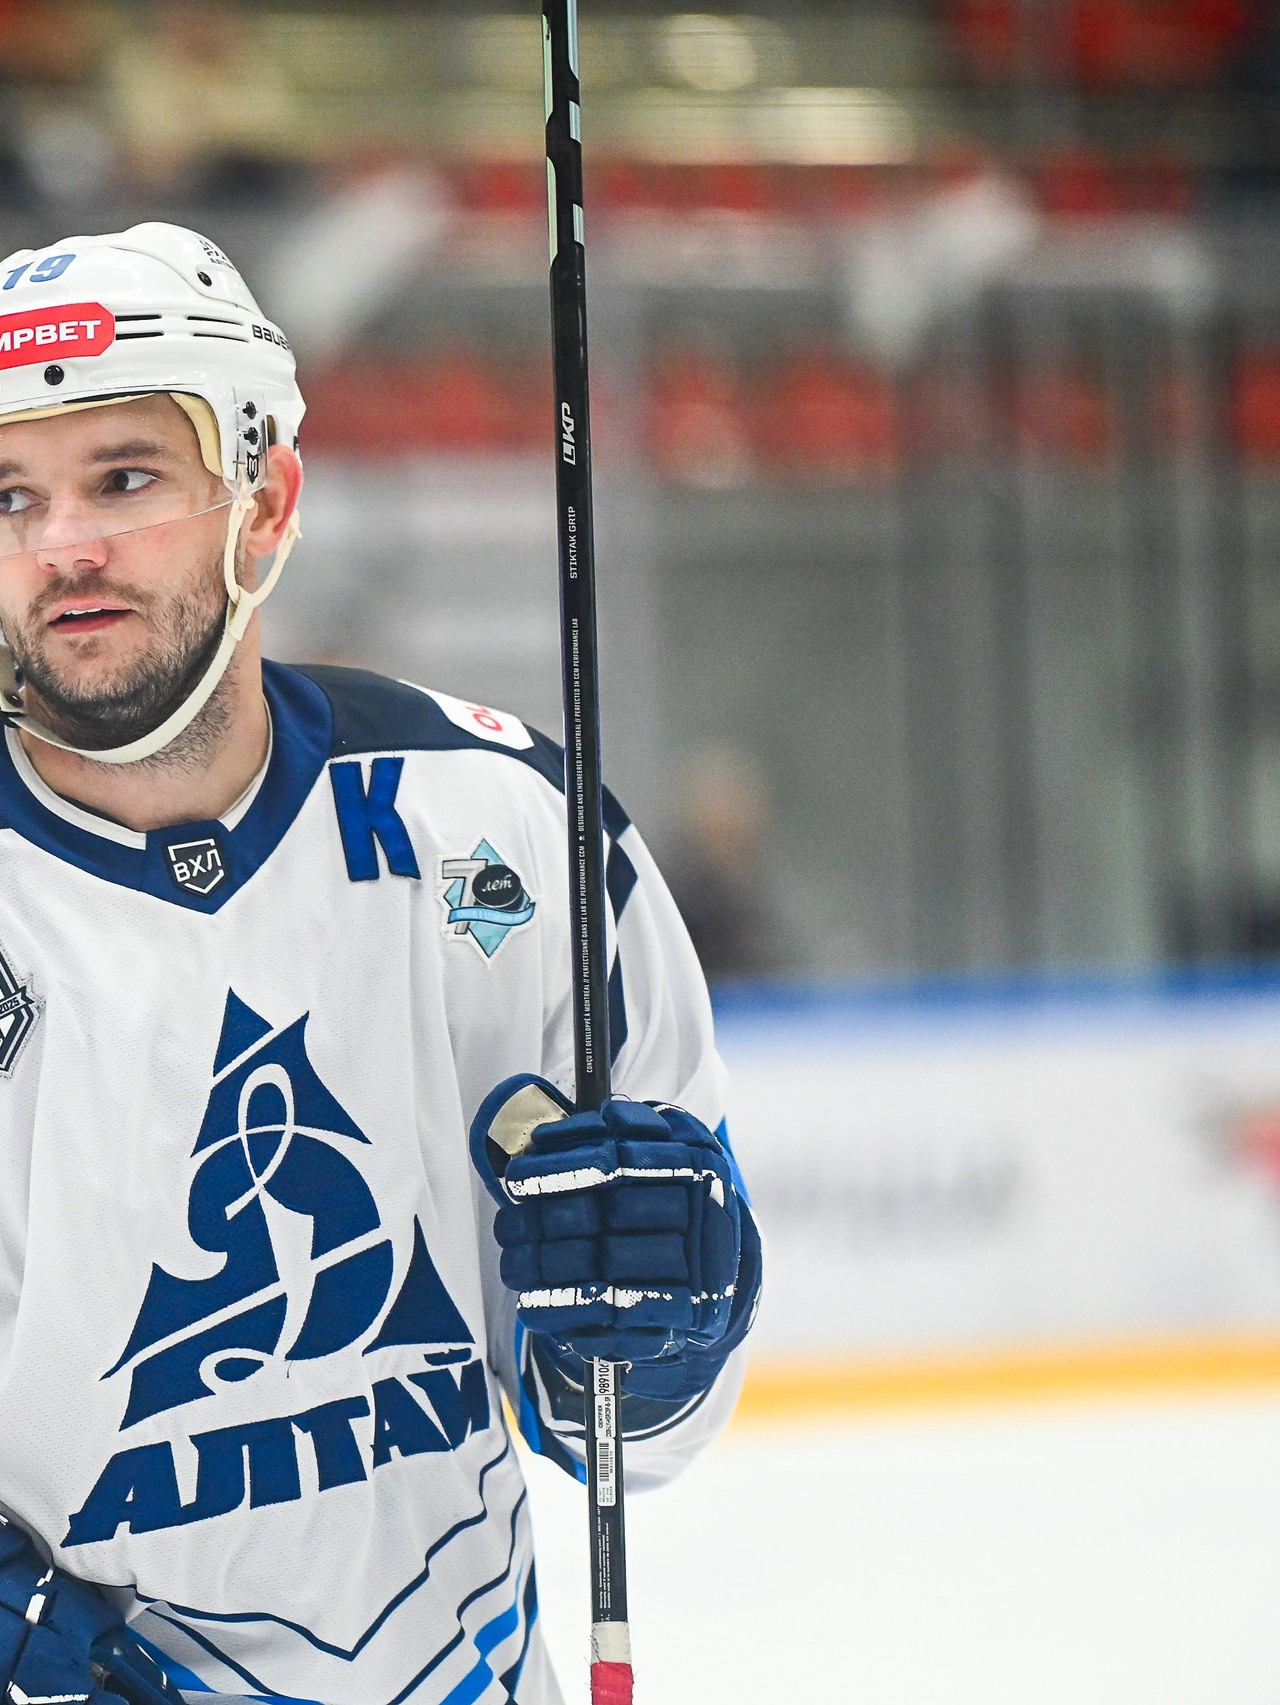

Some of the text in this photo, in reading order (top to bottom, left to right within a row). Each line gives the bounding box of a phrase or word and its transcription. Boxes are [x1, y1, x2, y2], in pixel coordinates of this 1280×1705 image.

[2, 254, 76, 291] 19
[567, 506, 578, 579] STIKTAK GRIP
[173, 849, 222, 882] ВХЛ
[60, 1348, 491, 1548] АЛТАЙ
